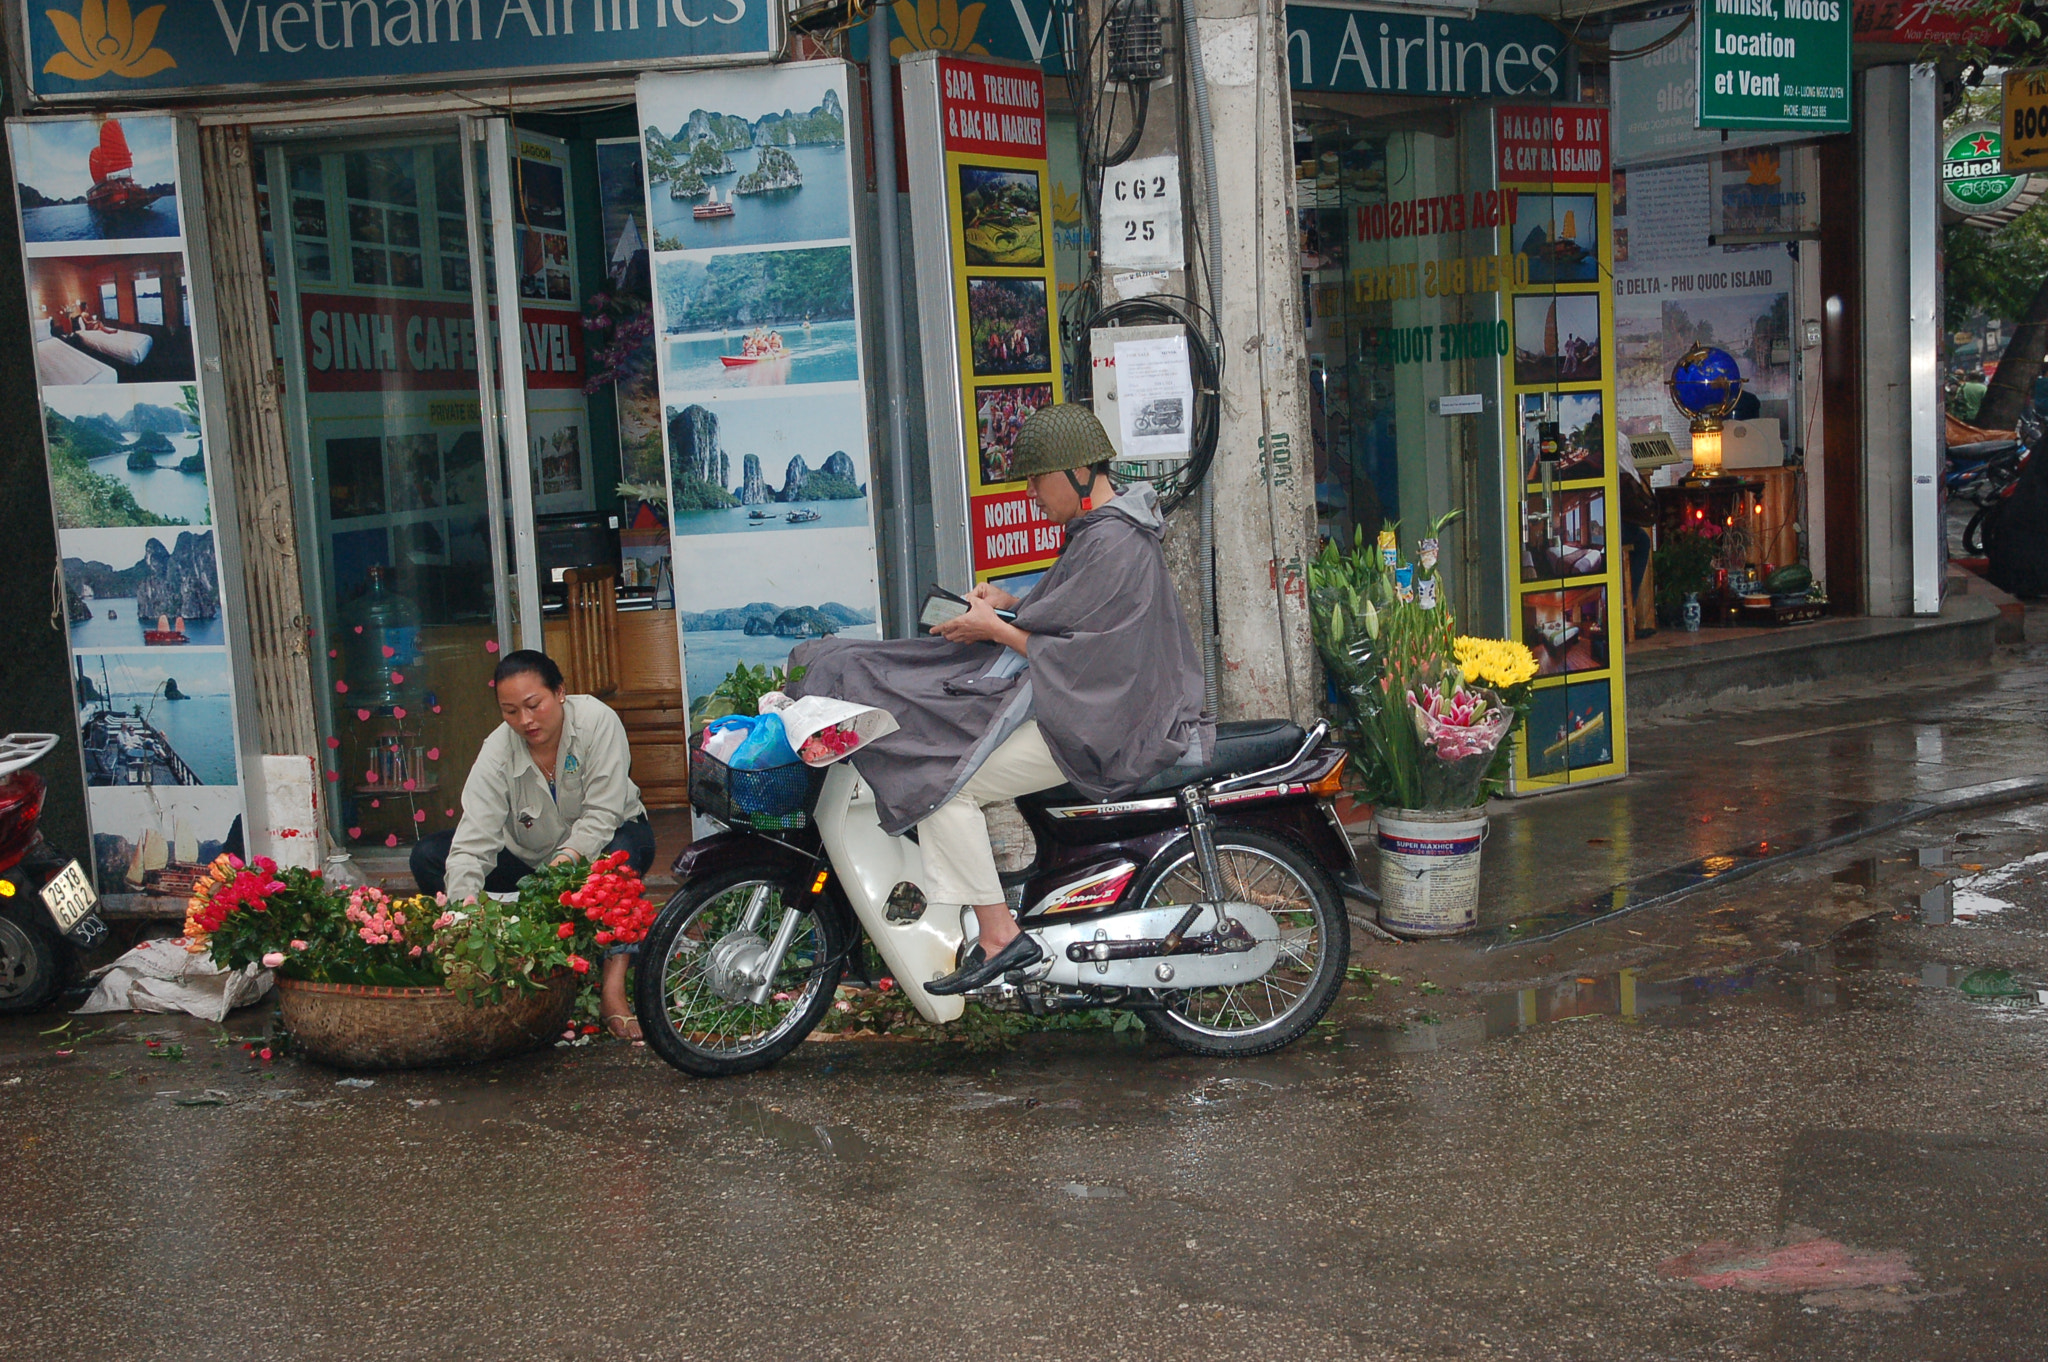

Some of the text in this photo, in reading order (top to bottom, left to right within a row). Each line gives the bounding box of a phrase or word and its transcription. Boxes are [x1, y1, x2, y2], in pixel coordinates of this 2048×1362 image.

[1784, 0, 1840, 22] Motos
[214, 0, 482, 56] Vietnam
[1904, 28, 1922, 40] Now
[1924, 28, 1960, 41] Everyone
[1329, 12, 1559, 96] Airlines
[1715, 28, 1795, 58] Location
[945, 68, 1039, 109] SAPA TREKKING
[1715, 70, 1780, 97] et Vent
[949, 107, 1042, 146] & BAC HA MARKET
[1503, 116, 1602, 142] HALONG BAY
[1503, 146, 1602, 172] & CAT BA ISLAND
[1943, 159, 2000, 179] Heinek
[1125, 220, 1155, 241] 25
[1627, 278, 1661, 295] DELTA
[1671, 275, 1694, 293] PHU
[1697, 272, 1728, 292] QUOC
[1731, 269, 1773, 288] ISLAND
[309, 310, 577, 372] SINH CAFE TAVEL
[1631, 439, 1673, 460] ORMATION
[984, 499, 1027, 529] NORTH
[986, 525, 1061, 560] NORTH EAST
[1396, 840, 1419, 849] SUPER
[60, 887, 92, 925] 6002
[1051, 894, 1102, 904] Dream
